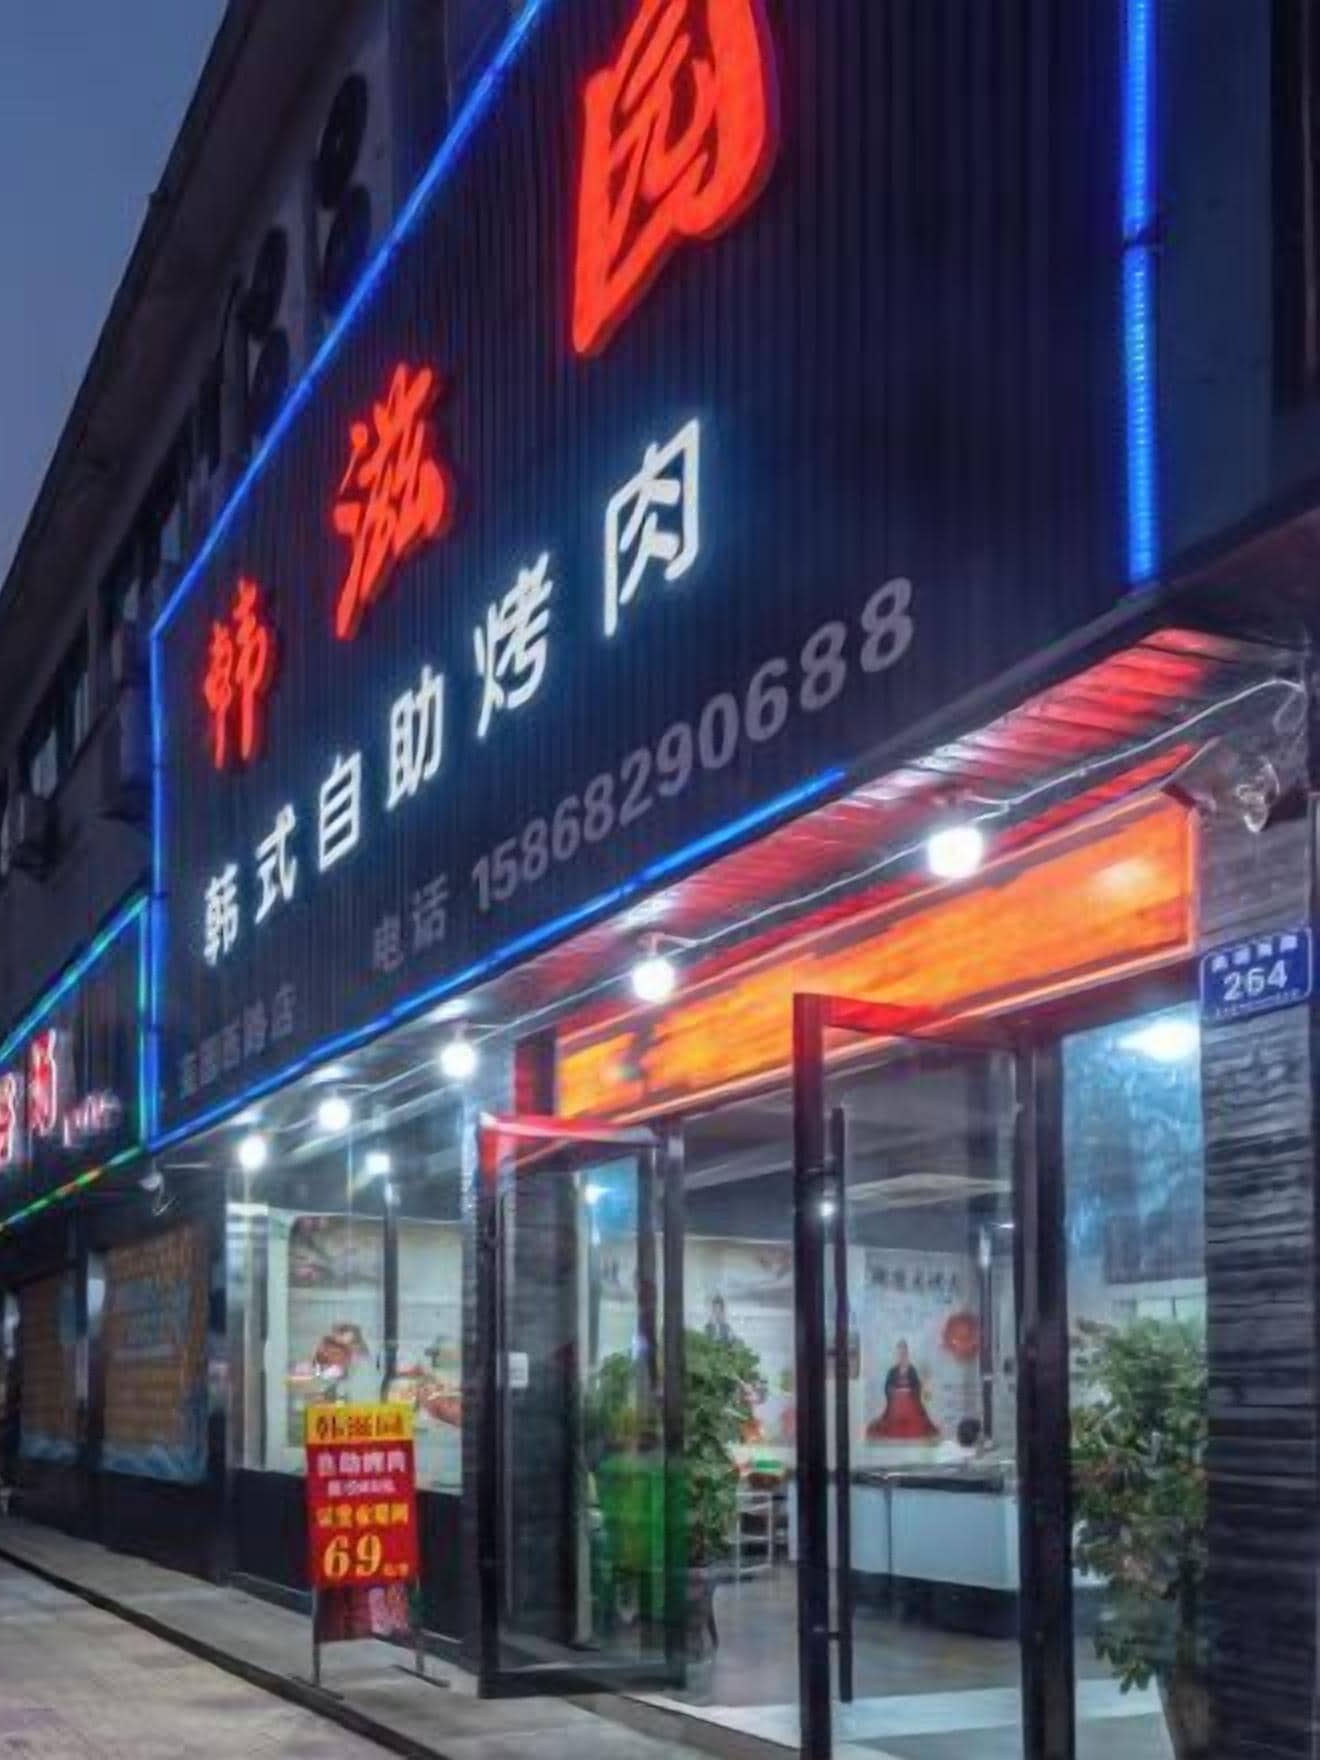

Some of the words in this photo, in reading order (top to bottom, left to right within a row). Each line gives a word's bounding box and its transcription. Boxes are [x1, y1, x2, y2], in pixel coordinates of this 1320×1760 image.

[204, 417, 700, 966] 韩式自助烤肉
[373, 873, 450, 970] 电话
[471, 576, 914, 912] 15868290688
[1223, 960, 1287, 1001] 264
[323, 1533, 382, 1580] 69
